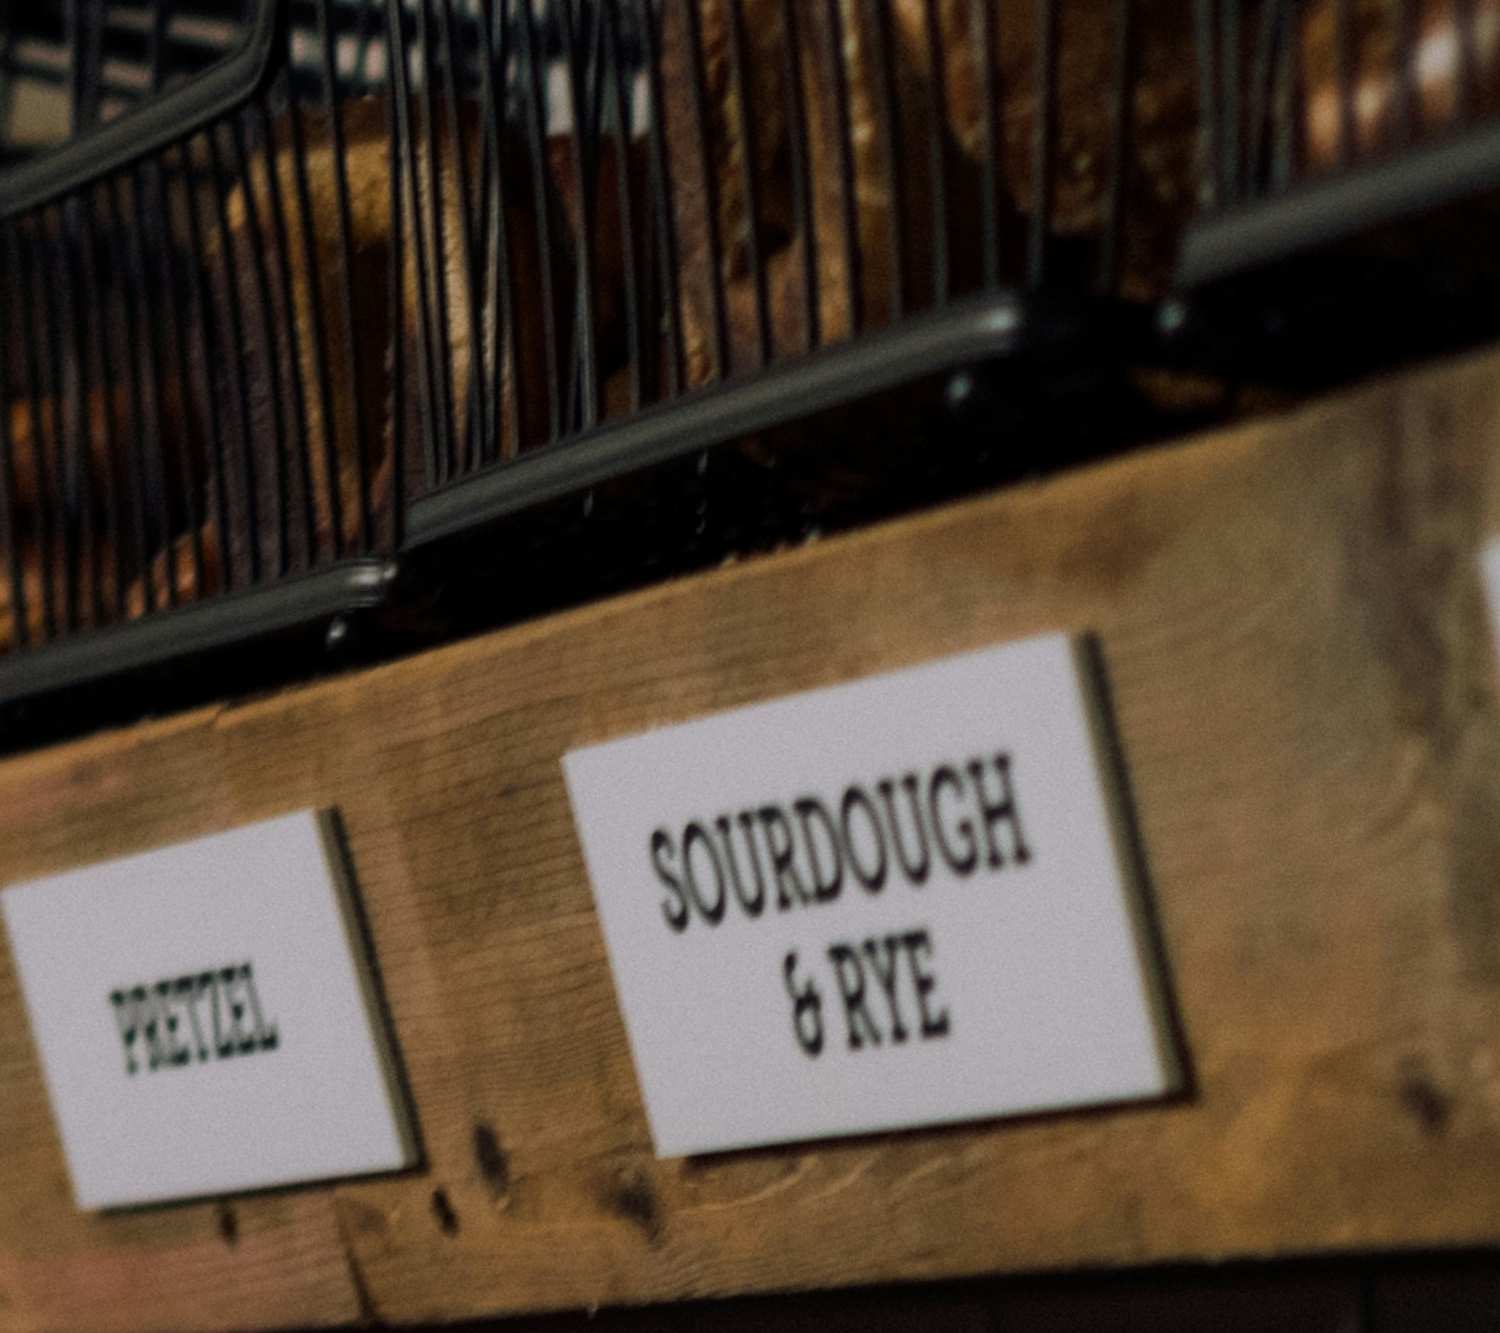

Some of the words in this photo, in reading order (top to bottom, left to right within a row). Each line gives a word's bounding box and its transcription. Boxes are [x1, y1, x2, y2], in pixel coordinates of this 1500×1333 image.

[649, 752, 1031, 933] SOURDOUGH
[109, 960, 279, 1075] PRETZEL
[783, 947, 825, 1057] &
[830, 928, 950, 1049] RYE
